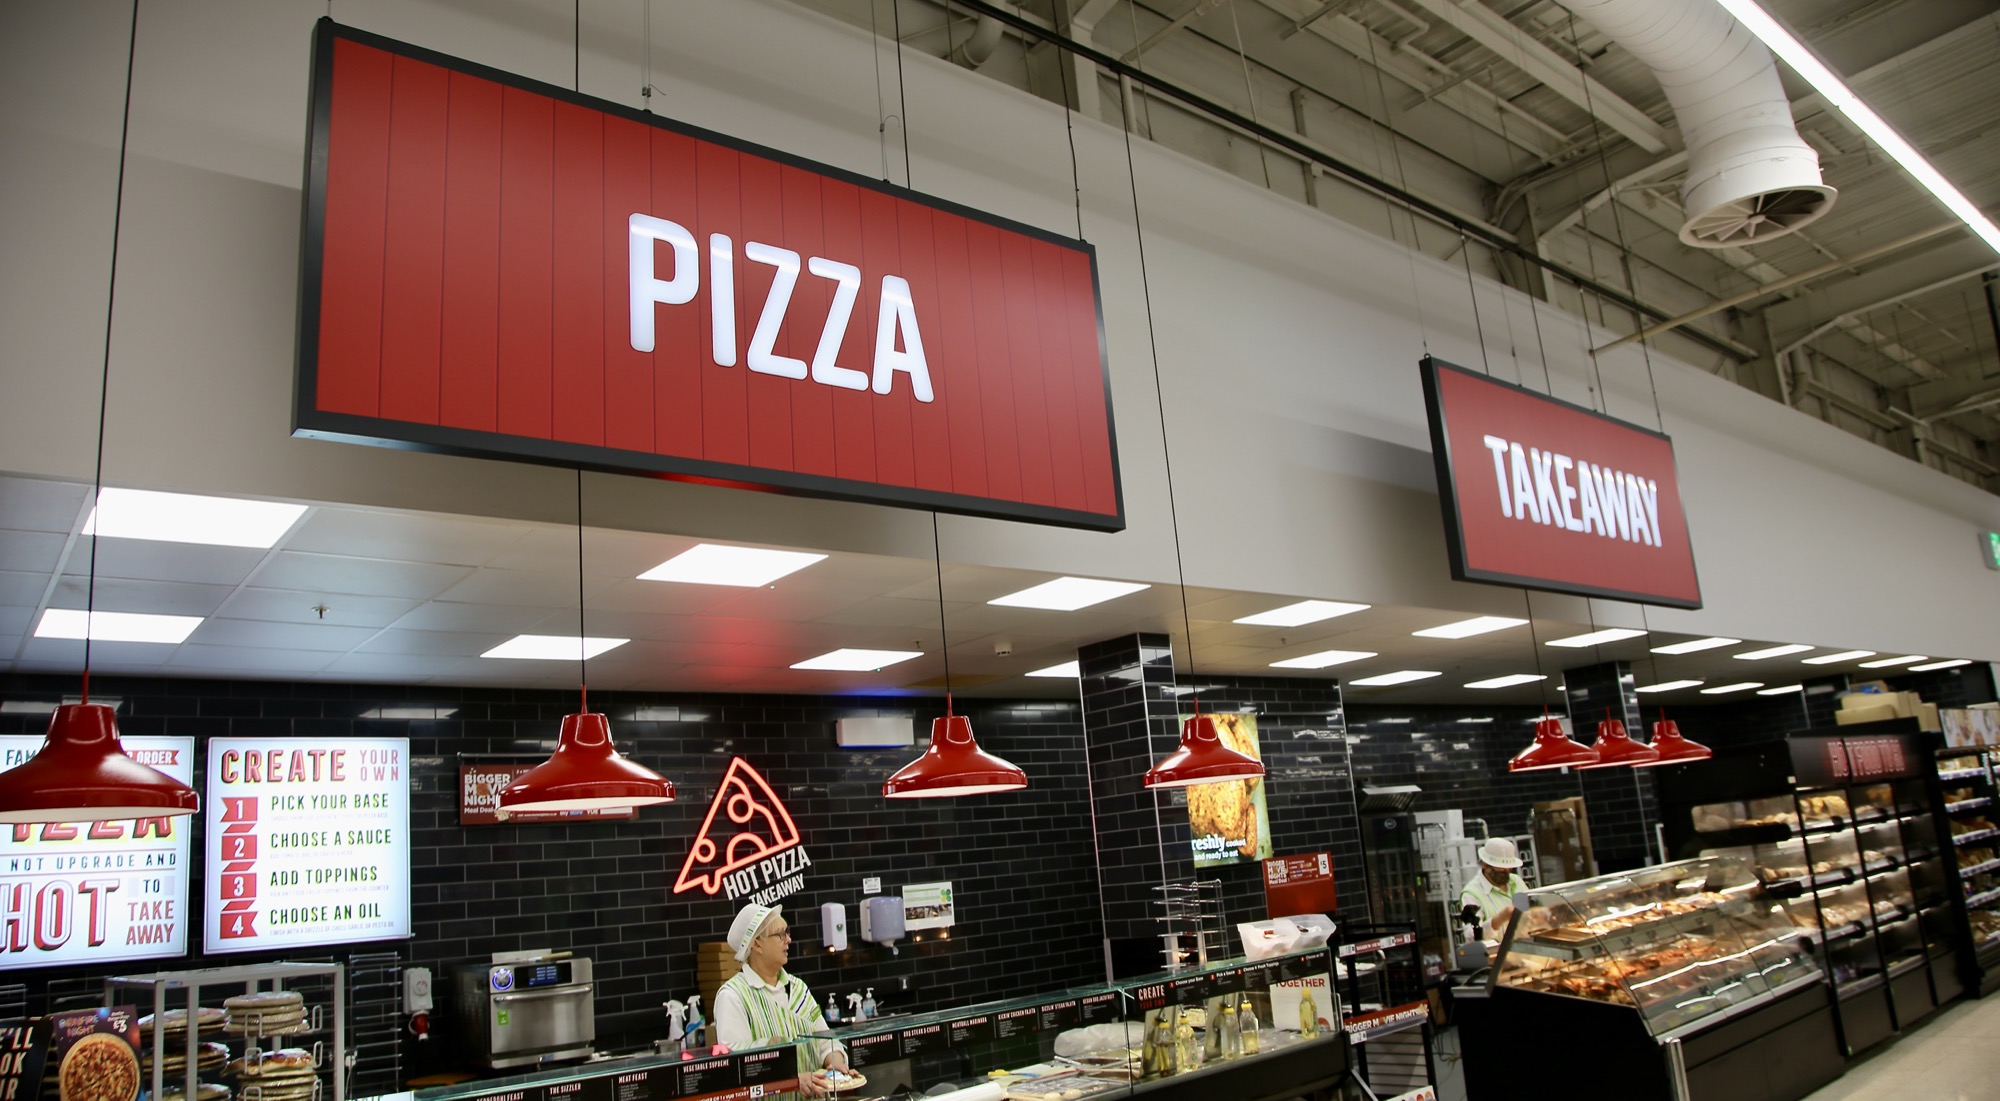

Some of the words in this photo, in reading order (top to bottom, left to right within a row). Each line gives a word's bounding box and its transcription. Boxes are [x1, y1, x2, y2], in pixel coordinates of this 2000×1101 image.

[629, 213, 934, 403] PIZZA
[1484, 434, 1662, 547] TAKEAWAY
[220, 749, 346, 783] CREATE
[360, 749, 399, 764] YOUR
[360, 766, 399, 781] OWN
[464, 774, 511, 784] BIGGER
[235, 800, 243, 820] 1
[271, 795, 305, 811] PICK
[311, 794, 347, 810] YOUR
[354, 793, 389, 808] BASE
[464, 796, 500, 806] NIGH
[234, 838, 244, 858] 2
[271, 832, 328, 849] CHOOSE
[334, 831, 342, 846] A
[348, 828, 392, 845] SAUCE
[11, 858, 44, 872] NOT
[56, 854, 136, 870] UPGRADE
[146, 853, 176, 866] AND
[723, 865, 759, 900] HOT
[760, 845, 811, 884] PIZZA
[234, 876, 244, 896] 3
[270, 870, 298, 886] ADD
[306, 866, 378, 885] TOPPINGS
[749, 874, 804, 906] TAKEAWAY
[0, 878, 120, 953] HOT
[143, 879, 160, 893] TO
[128, 900, 174, 922] TAKE
[232, 916, 244, 936] 4
[270, 906, 328, 925] CHOOSE
[334, 904, 352, 922] AN
[358, 902, 381, 919] OIL
[126, 924, 174, 946] AWAY
[1138, 984, 1165, 1000] CREATE
[58, 1014, 99, 1028] BONFIRE
[66, 1024, 96, 1037] NIGHT
[113, 1020, 127, 1033] £3
[683, 1062, 708, 1074] VEGETABLE
[709, 1059, 729, 1069] SUPREME
[550, 1085, 559, 1095] THE
[560, 1082, 581, 1093] SIZZLER
[619, 1075, 631, 1084] MEAT
[632, 1072, 648, 1082] FEAST
